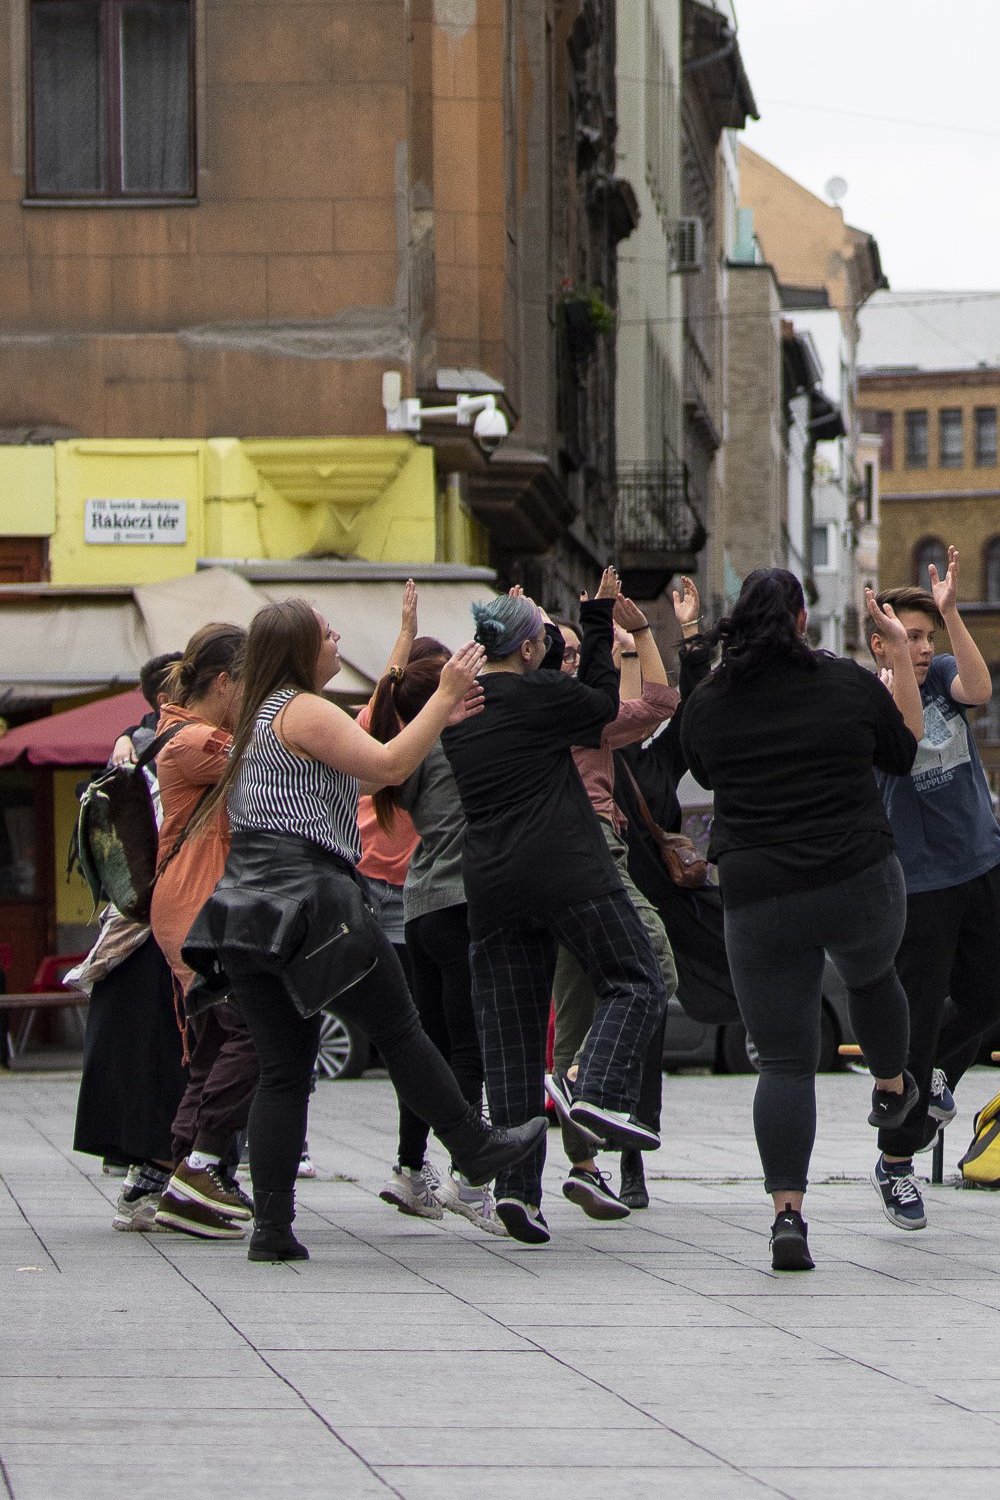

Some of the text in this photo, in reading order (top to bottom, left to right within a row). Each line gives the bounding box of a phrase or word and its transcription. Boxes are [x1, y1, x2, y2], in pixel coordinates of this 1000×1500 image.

[92, 512, 179, 528] Rákóczi tér
[914, 771, 952, 791] SUPPLIES
